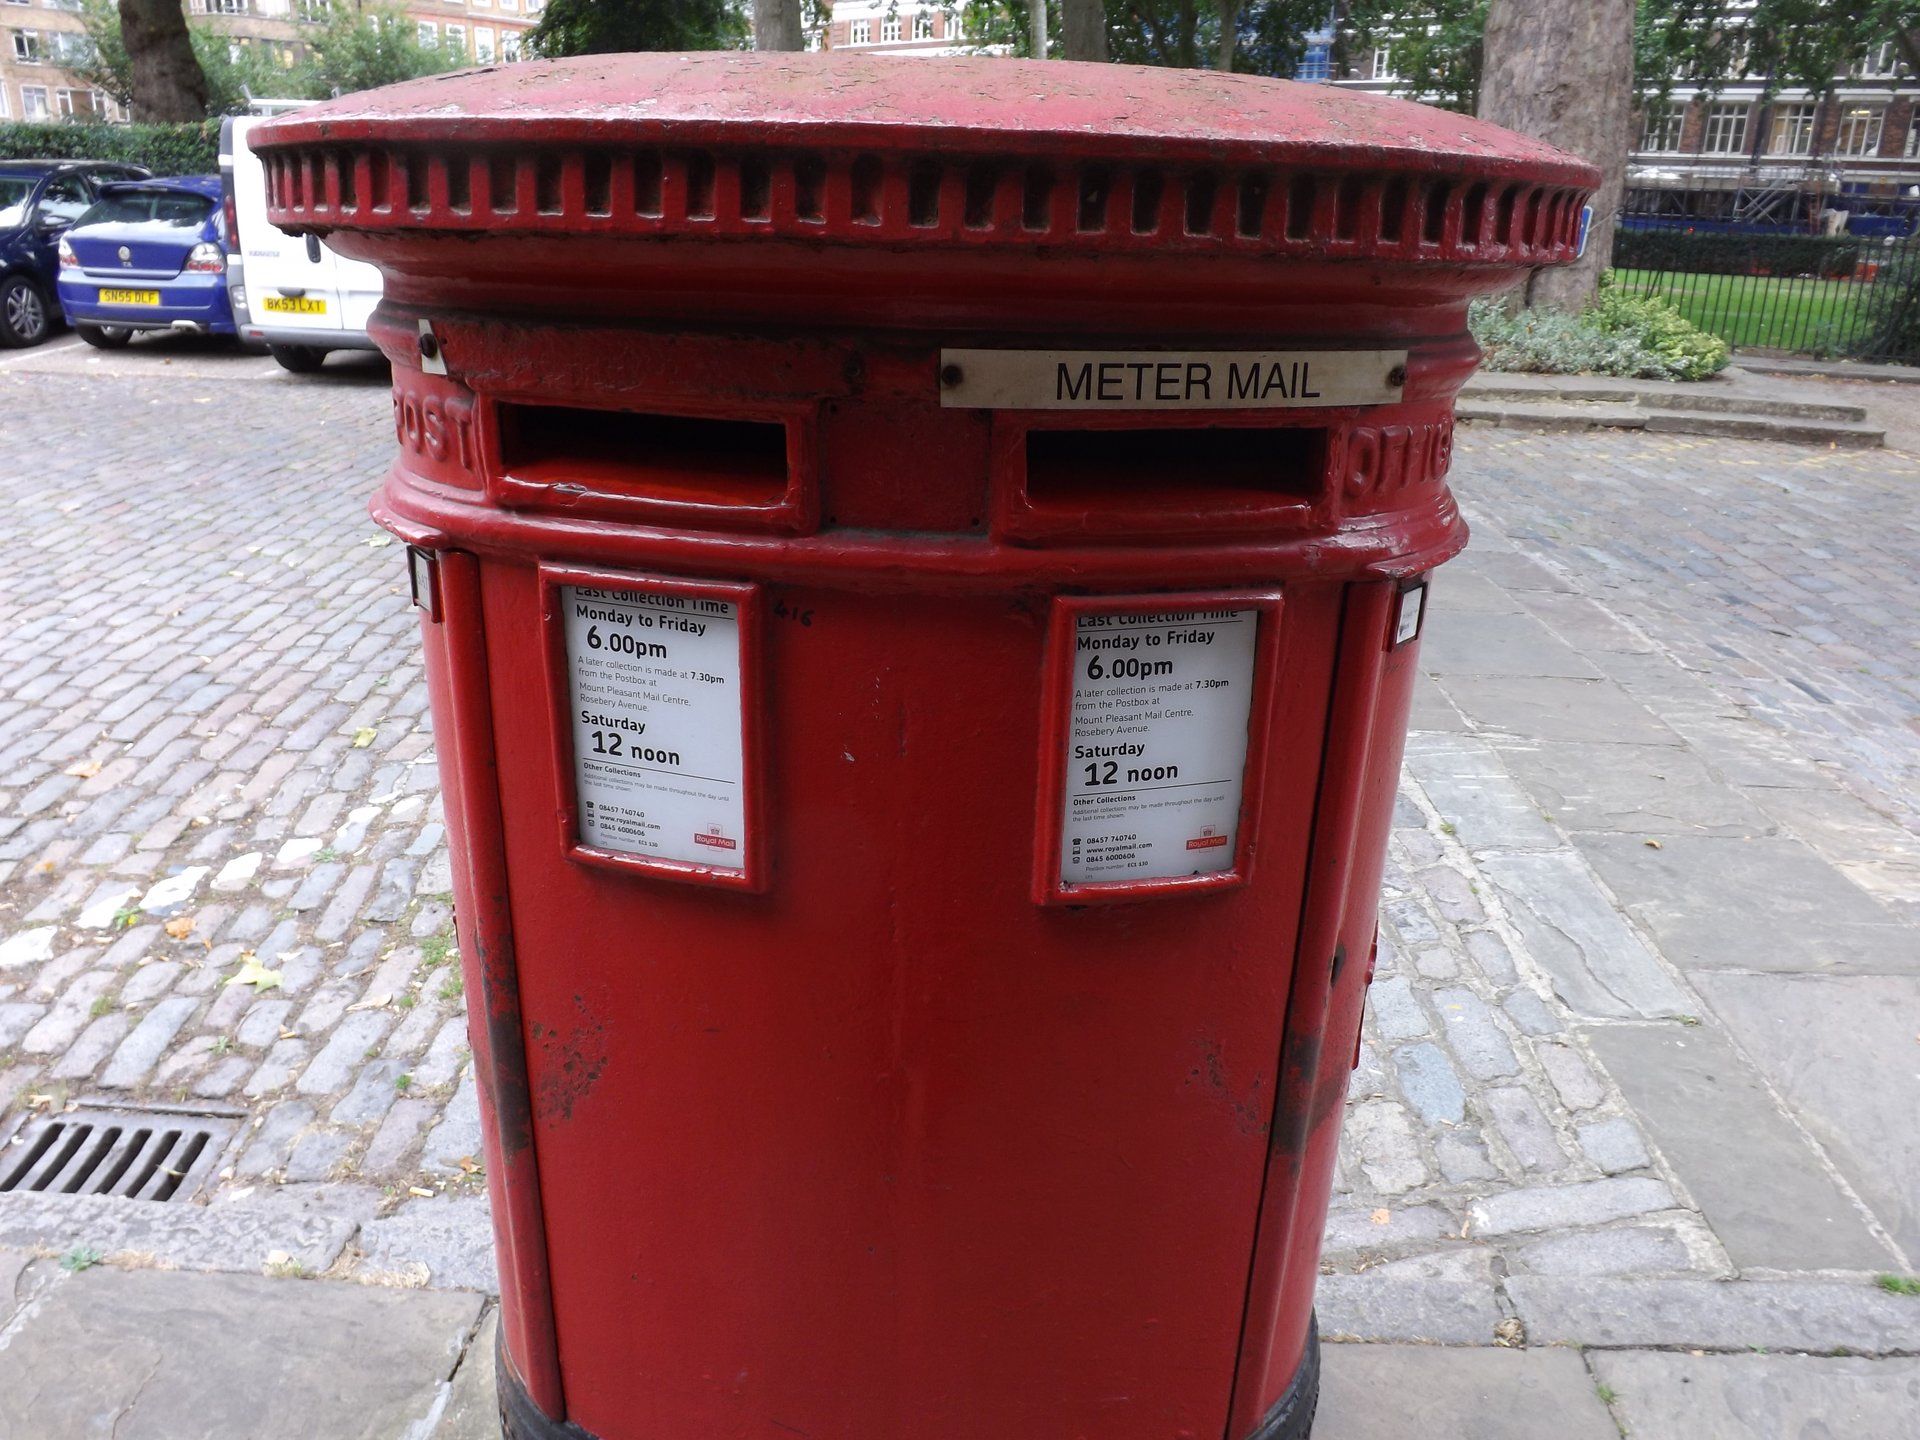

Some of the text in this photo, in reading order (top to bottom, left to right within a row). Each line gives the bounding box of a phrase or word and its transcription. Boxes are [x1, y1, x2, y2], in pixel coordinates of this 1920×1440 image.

[105, 290, 131, 301] SN55
[267, 297, 321, 312] BK53 LXT
[1056, 362, 1320, 400] METER MAIL
[392, 393, 476, 470] POST
[576, 586, 728, 613] Last Collection Time
[576, 604, 706, 636] Monday to Friday
[1078, 616, 1112, 628] Last
[1119, 612, 1195, 625] Collection
[587, 625, 667, 659] 6.00pm
[1078, 630, 1215, 650] Monday to Friday
[579, 668, 597, 677] from
[600, 671, 612, 680] the
[616, 674, 646, 685] Postbox
[586, 657, 603, 666] later
[606, 660, 642, 672] collection
[655, 668, 677, 677] made
[680, 670, 688, 679] at
[690, 672, 724, 684] 7.30pm
[1088, 655, 1173, 681] 6.00pm
[580, 683, 691, 706] Mount Pleasant Mail Centre.
[1076, 690, 1082, 698] A
[1084, 689, 1103, 698] later
[1107, 685, 1146, 696] collection
[1149, 684, 1155, 693] is
[1159, 683, 1182, 692] made
[1196, 679, 1229, 690] 7.30pm
[580, 694, 649, 712] Rosebery Avenue.
[1075, 697, 1160, 711] from the Postbox at
[582, 711, 646, 734] Saturday
[1075, 717, 1102, 725] Mount
[1106, 713, 1141, 724] Pleasant
[1145, 711, 1162, 720] Mail
[1075, 725, 1150, 737] Rosebery Avenue.
[592, 731, 679, 765] 12 noon
[1075, 742, 1145, 759] Saturday
[584, 763, 641, 777] Other Collections
[1085, 761, 1178, 786] 12 noon
[1073, 794, 1136, 806] Other Collections
[599, 804, 645, 818] 08457 740740
[600, 815, 660, 830] www.royalmail.com
[600, 823, 615, 831] 0845
[696, 835, 735, 847] Royal Mail
[1111, 834, 1136, 842] 740740
[1087, 843, 1152, 853] www.royalmail.com
[1106, 853, 1135, 861] 6000606
